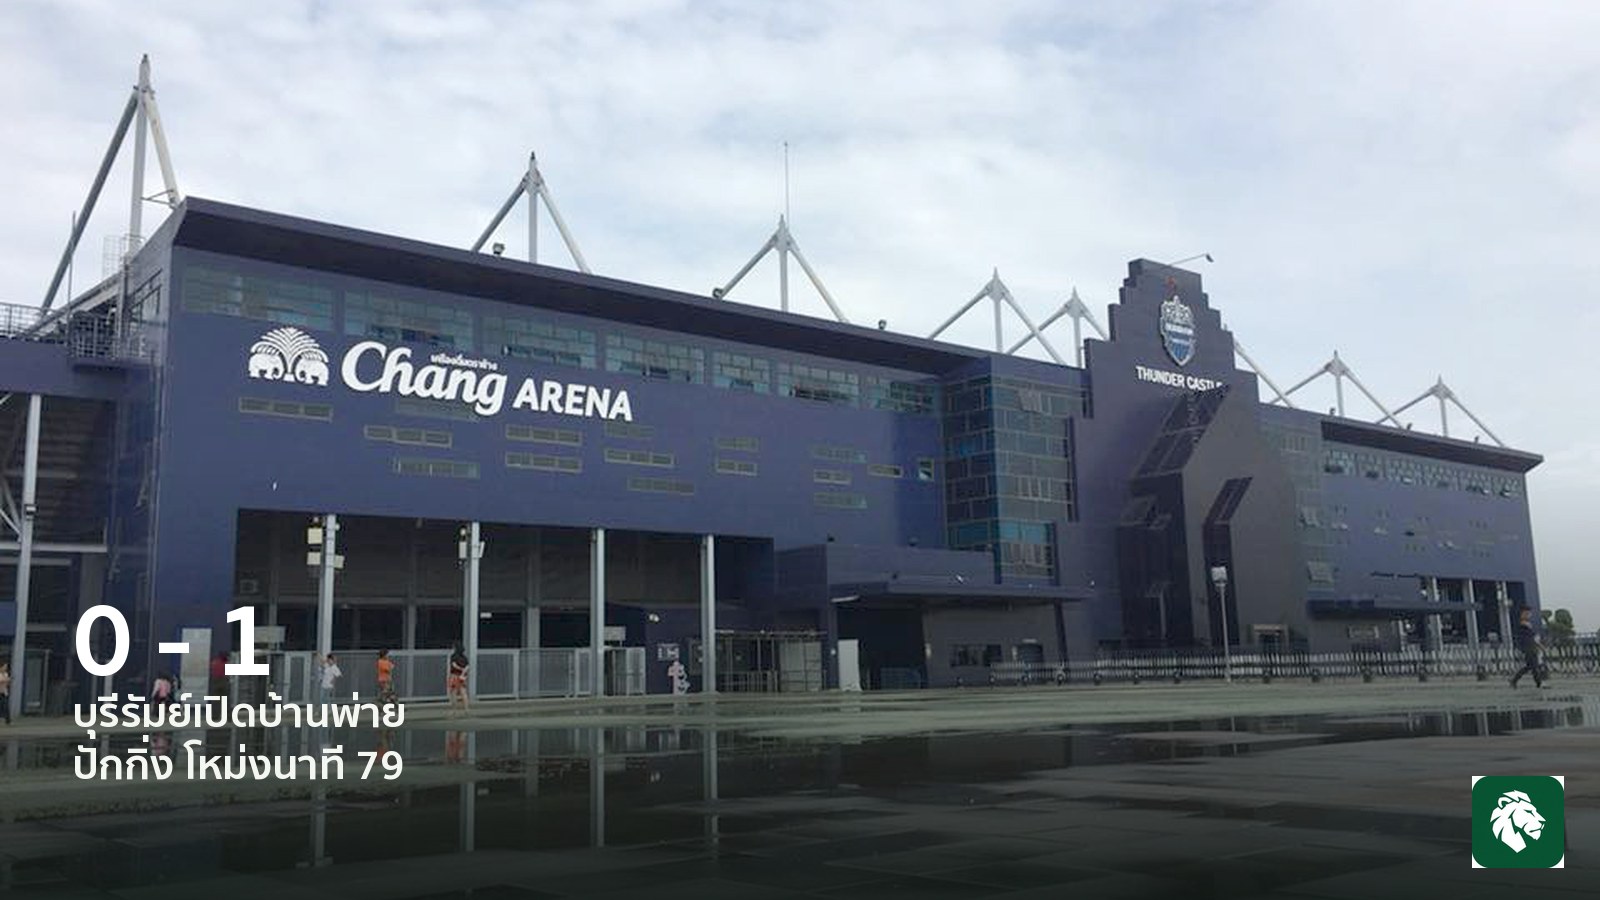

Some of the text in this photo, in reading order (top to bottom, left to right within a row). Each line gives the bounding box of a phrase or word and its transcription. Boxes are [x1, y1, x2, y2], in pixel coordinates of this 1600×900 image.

[341, 340, 633, 422] Chang ARENA
[1135, 365, 1185, 388] THUNDER
